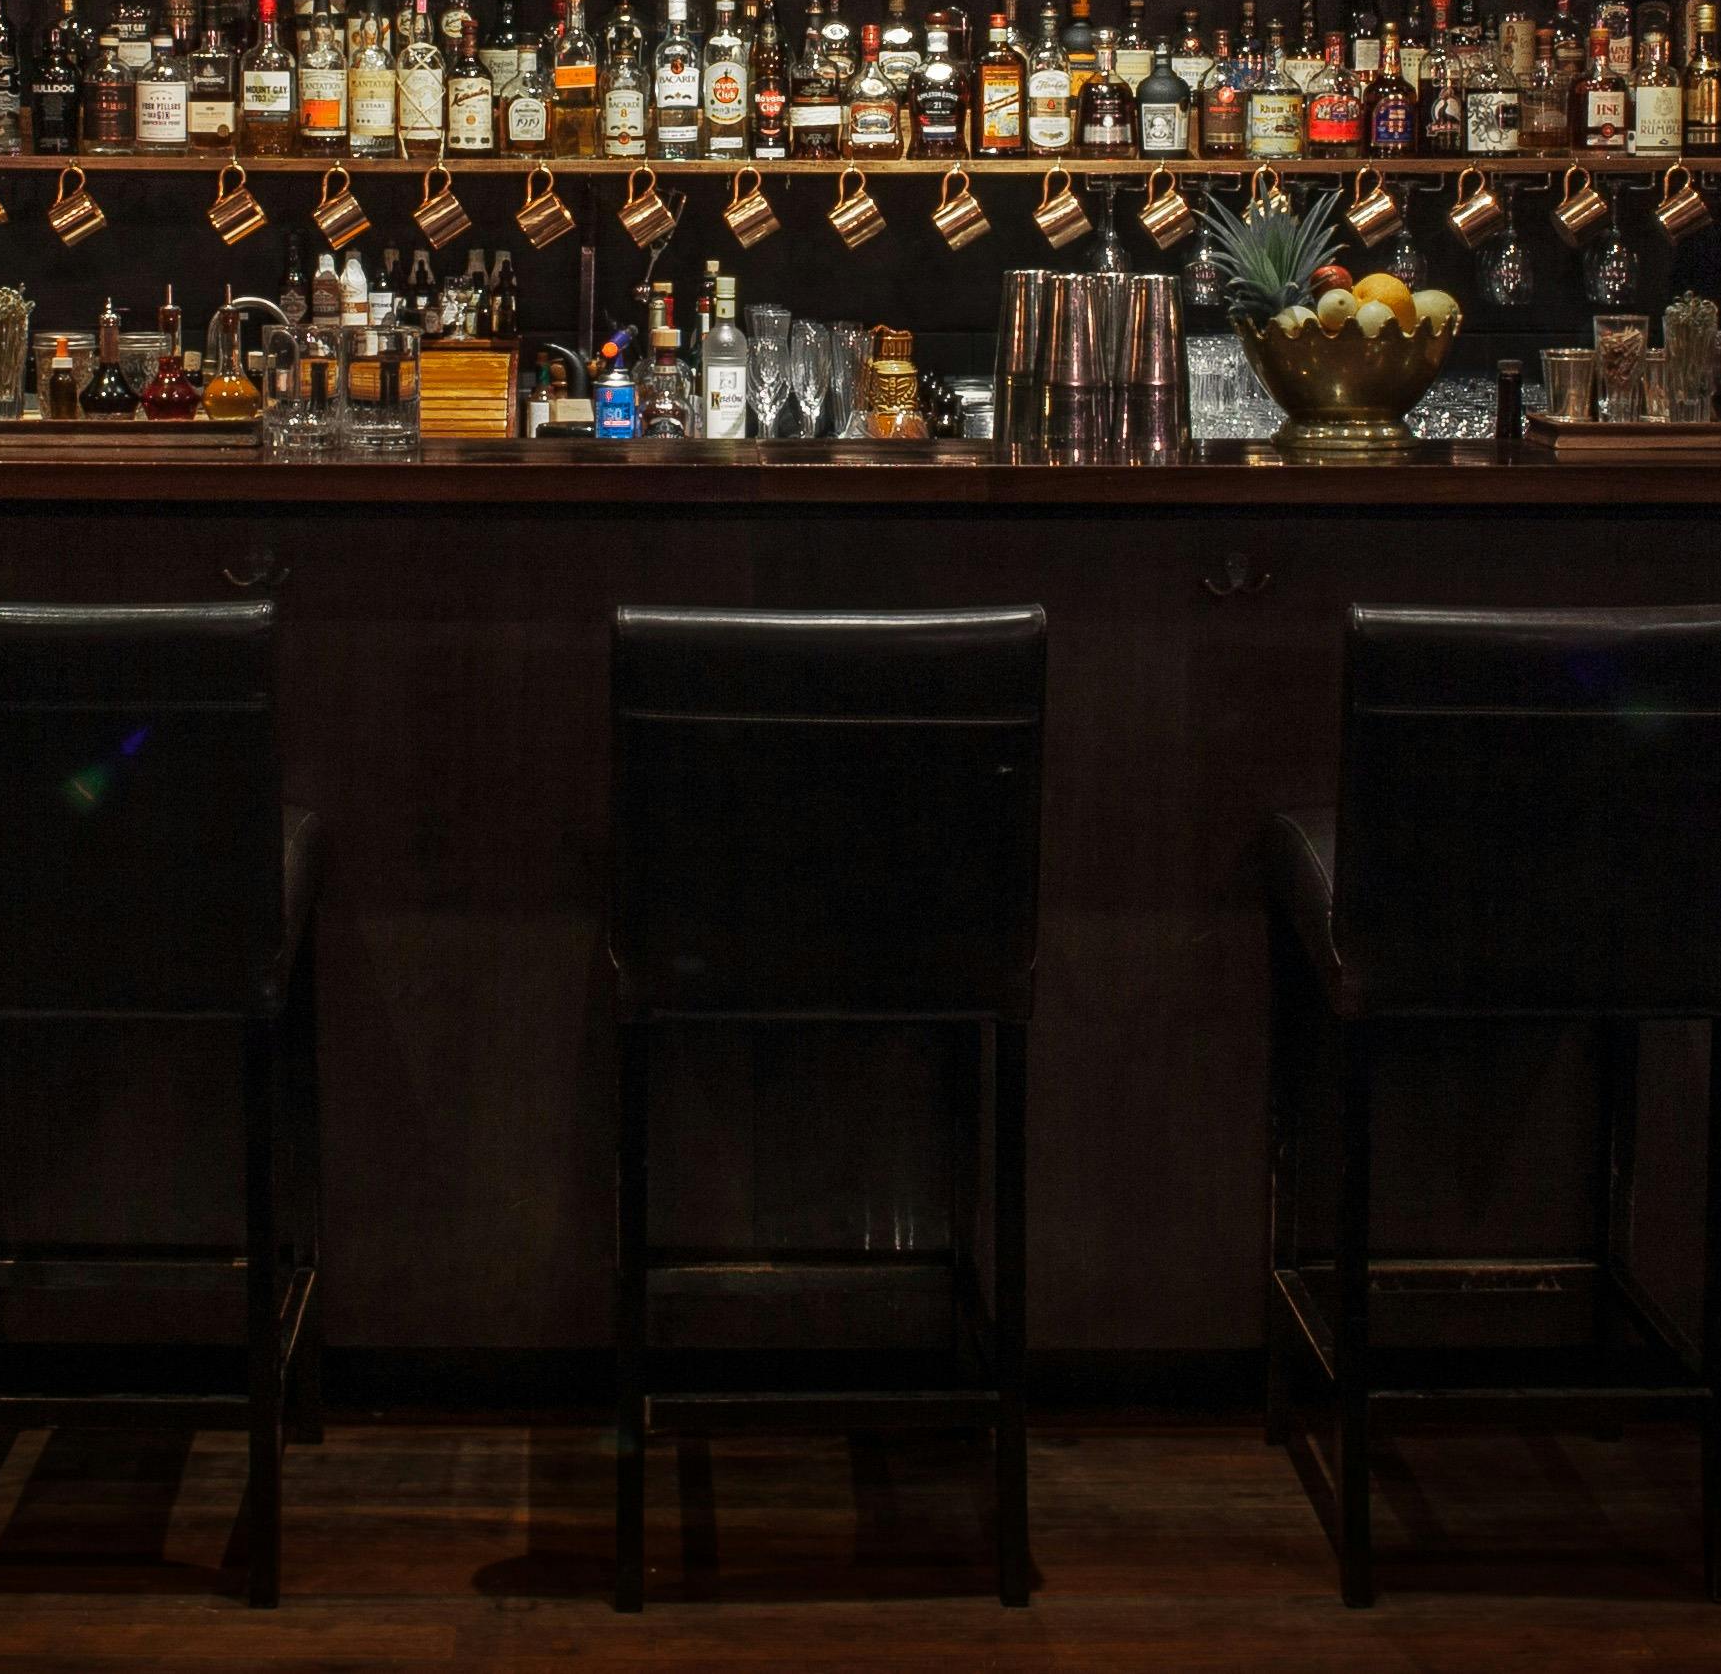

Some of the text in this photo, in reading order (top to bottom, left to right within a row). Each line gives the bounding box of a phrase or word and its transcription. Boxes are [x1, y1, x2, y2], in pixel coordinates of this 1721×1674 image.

[659, 75, 696, 85] BACARDI
[32, 84, 76, 93] BULLDOG
[245, 85, 288, 95] MOUNT GAY
[716, 90, 736, 100] Club
[755, 94, 786, 103] Havana
[608, 101, 640, 109] BACARDI
[760, 103, 781, 113] Club
[1260, 103, 1284, 114] Rhum
[620, 109, 627, 118] 8
[710, 391, 731, 411] Ketel
